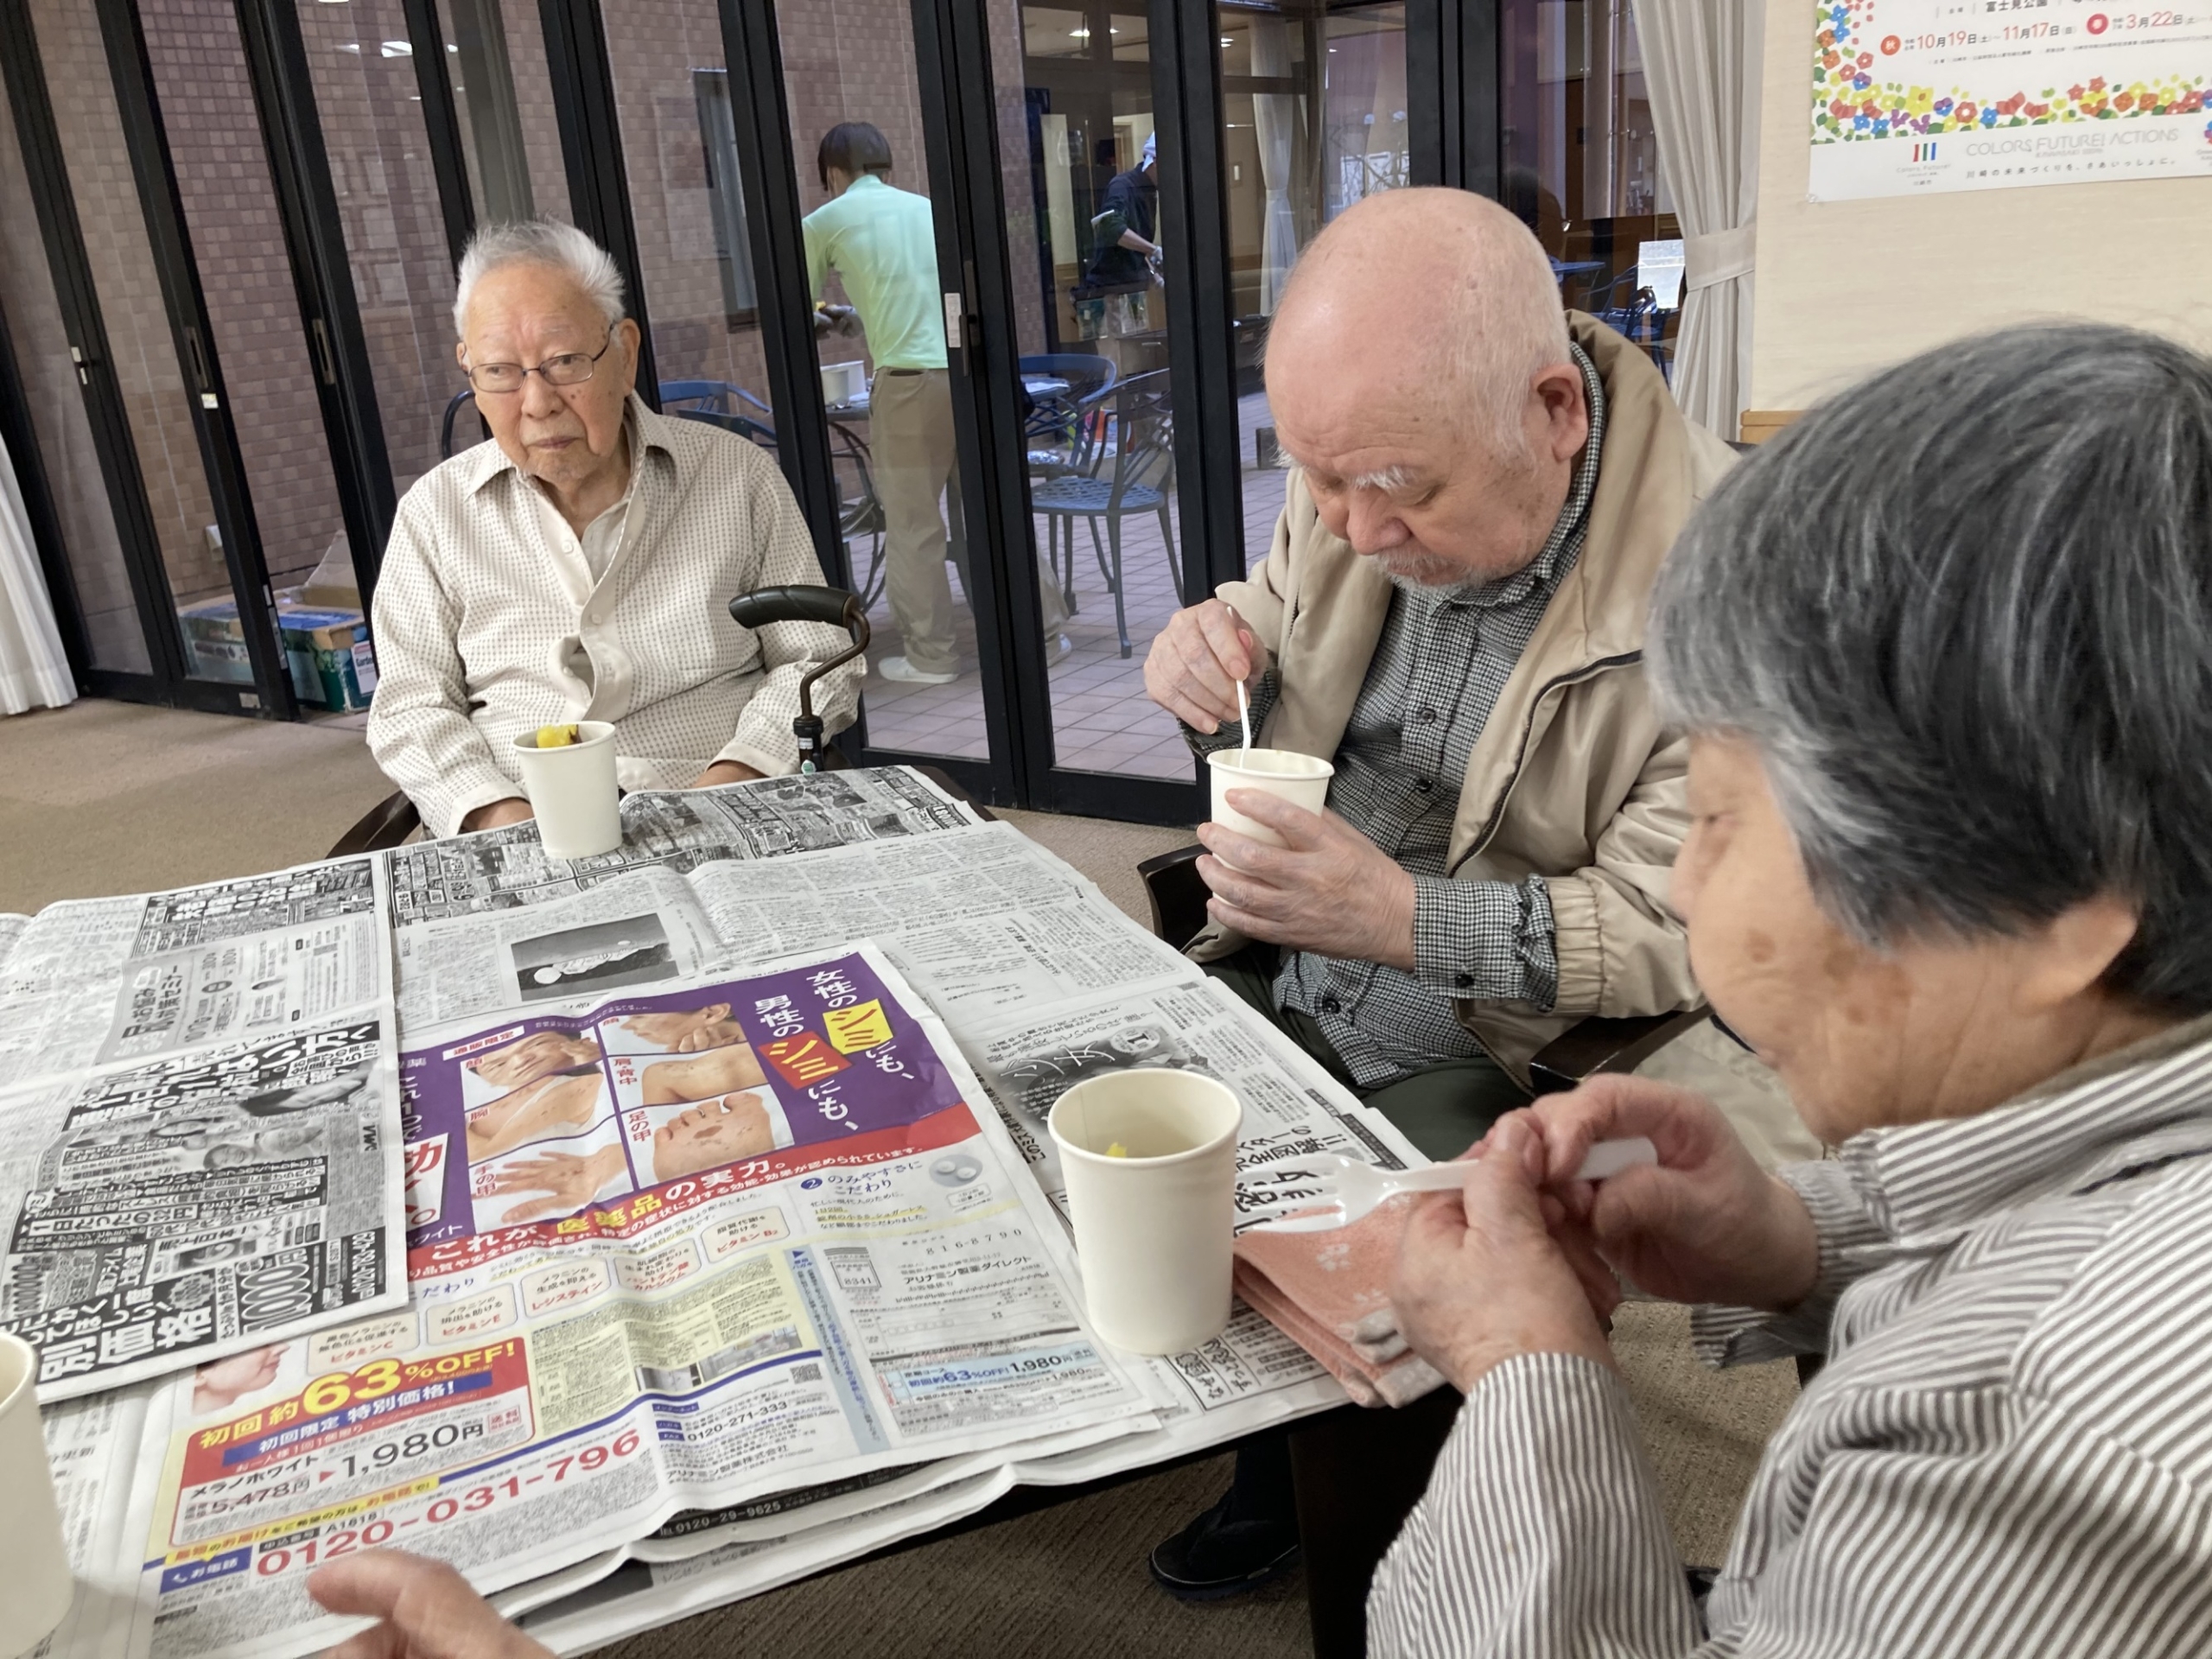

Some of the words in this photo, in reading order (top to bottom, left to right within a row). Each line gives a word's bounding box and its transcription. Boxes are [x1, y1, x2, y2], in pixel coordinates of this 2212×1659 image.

[1966, 139, 2032, 156] COLORS
[2109, 128, 2179, 146] ACTIONS
[806, 969, 915, 1080] 女性のシミにも、
[754, 994, 859, 1131] 男性のシミにも、
[628, 1109, 652, 1142] 足の甲
[828, 1160, 924, 1185] のみやすさに
[835, 1179, 892, 1195] こだわり
[432, 1160, 787, 1261] これが、医薬品の実力。
[903, 1255, 1033, 1285] アリナミン製薬ダイレクト
[330, 1340, 394, 1363] ビタミンC
[1009, 1354, 1074, 1374] 1,980円
[341, 1423, 484, 1480] 1,980円
[190, 1455, 320, 1500] メラノホワイト
[211, 1477, 312, 1514] 5,478円
[257, 1428, 641, 1577] 0120-031-796
